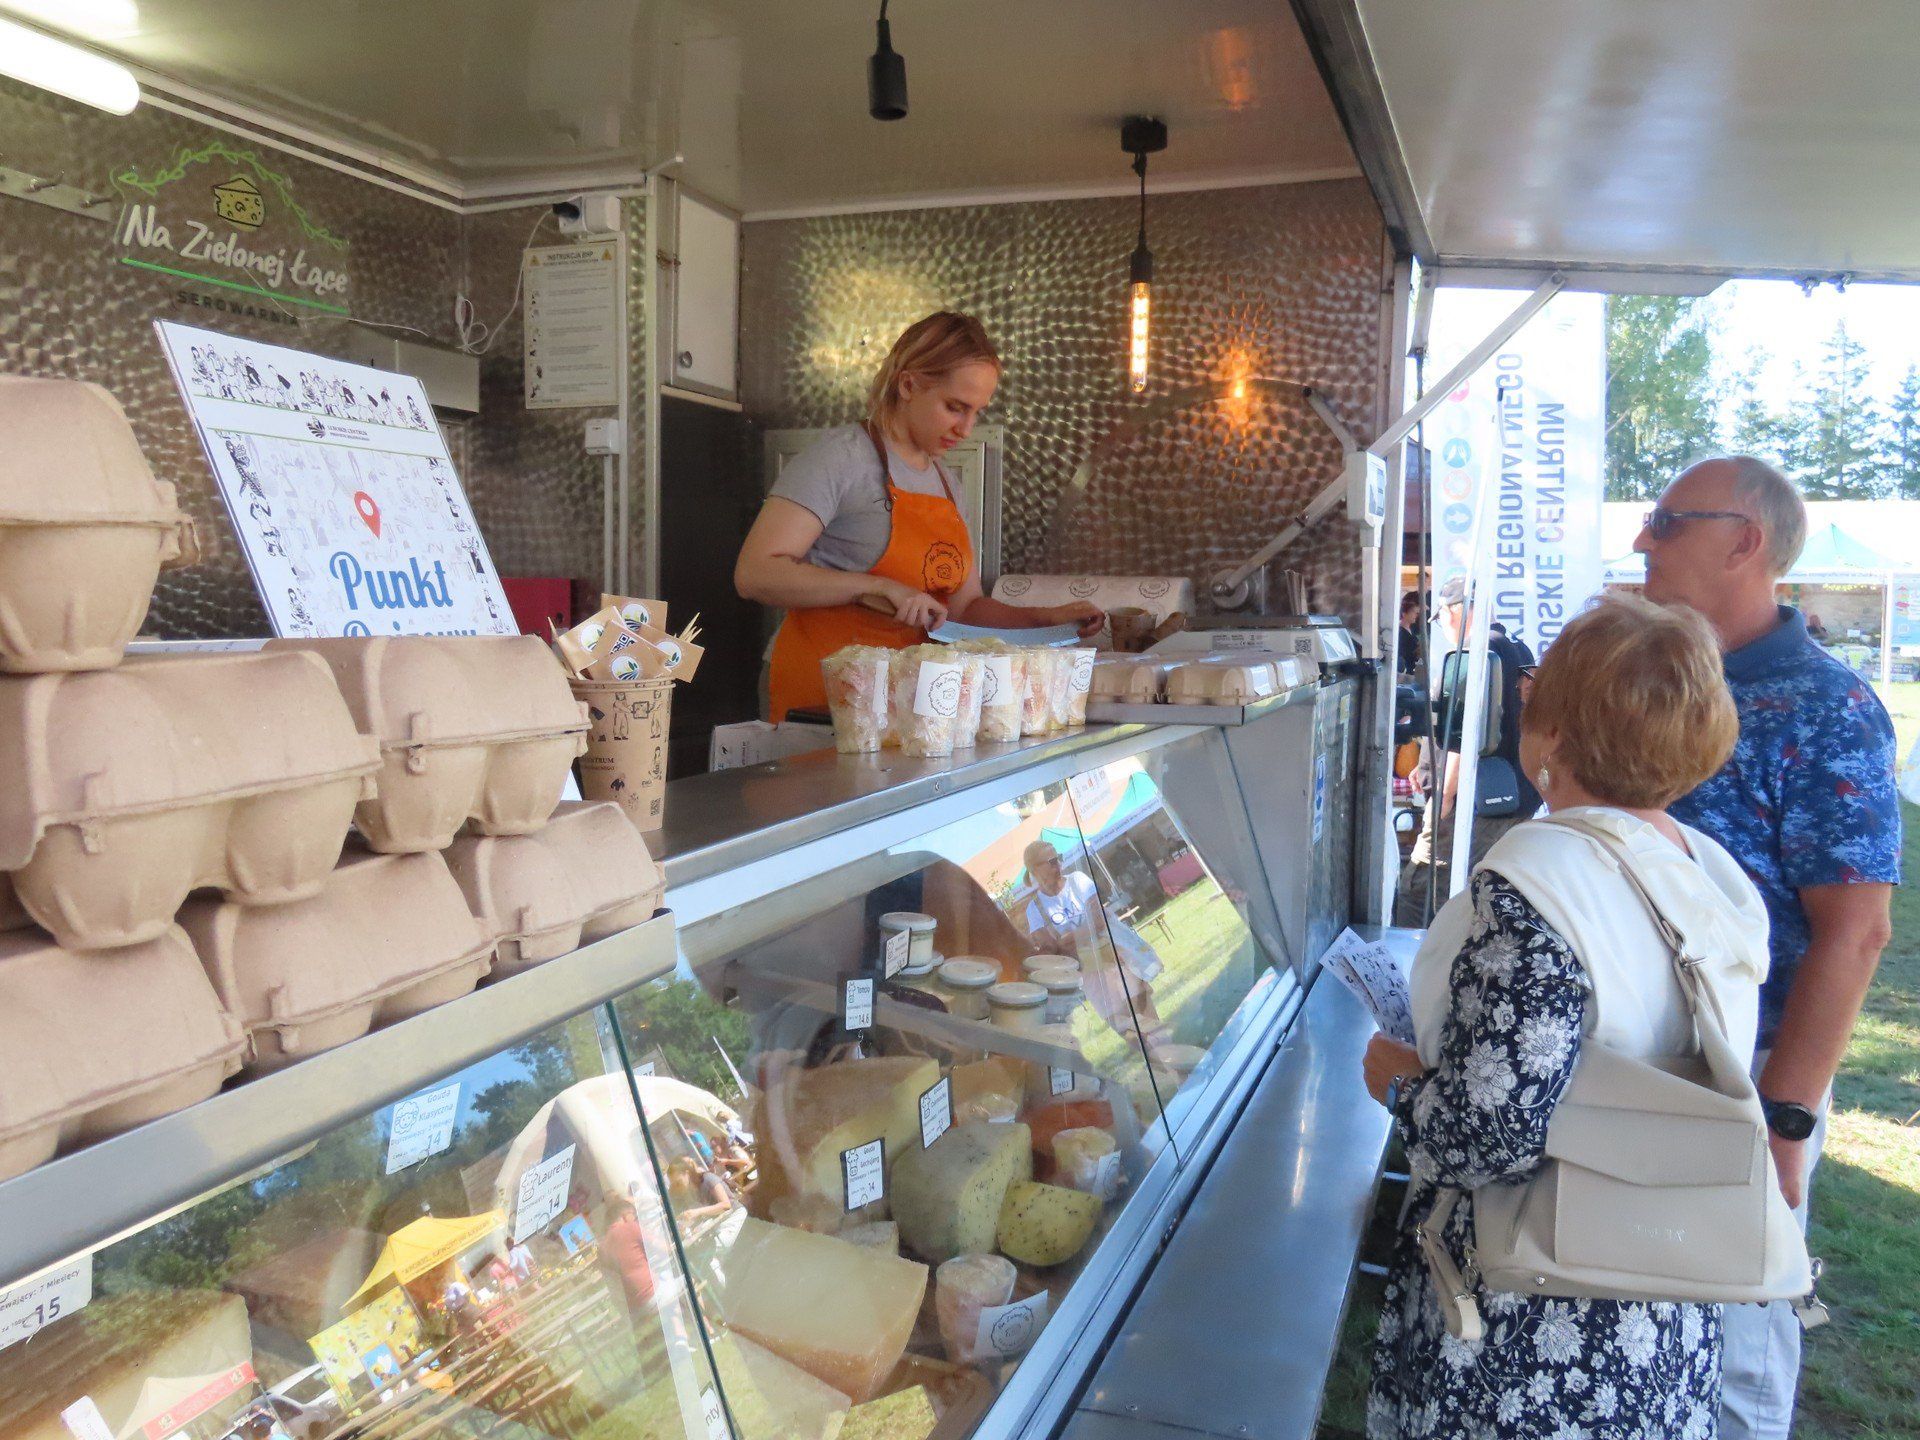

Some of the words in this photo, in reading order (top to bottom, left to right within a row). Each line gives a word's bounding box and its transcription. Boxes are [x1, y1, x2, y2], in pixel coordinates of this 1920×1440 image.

[121, 204, 175, 251] Na
[179, 219, 287, 289] Zielonej
[176, 290, 300, 326] SEROWARNIA
[328, 551, 454, 611] Punkt
[426, 1089, 452, 1104] Gouda
[427, 1130, 442, 1150] 14
[548, 1194, 561, 1213] 14
[35, 1295, 61, 1324] 15
